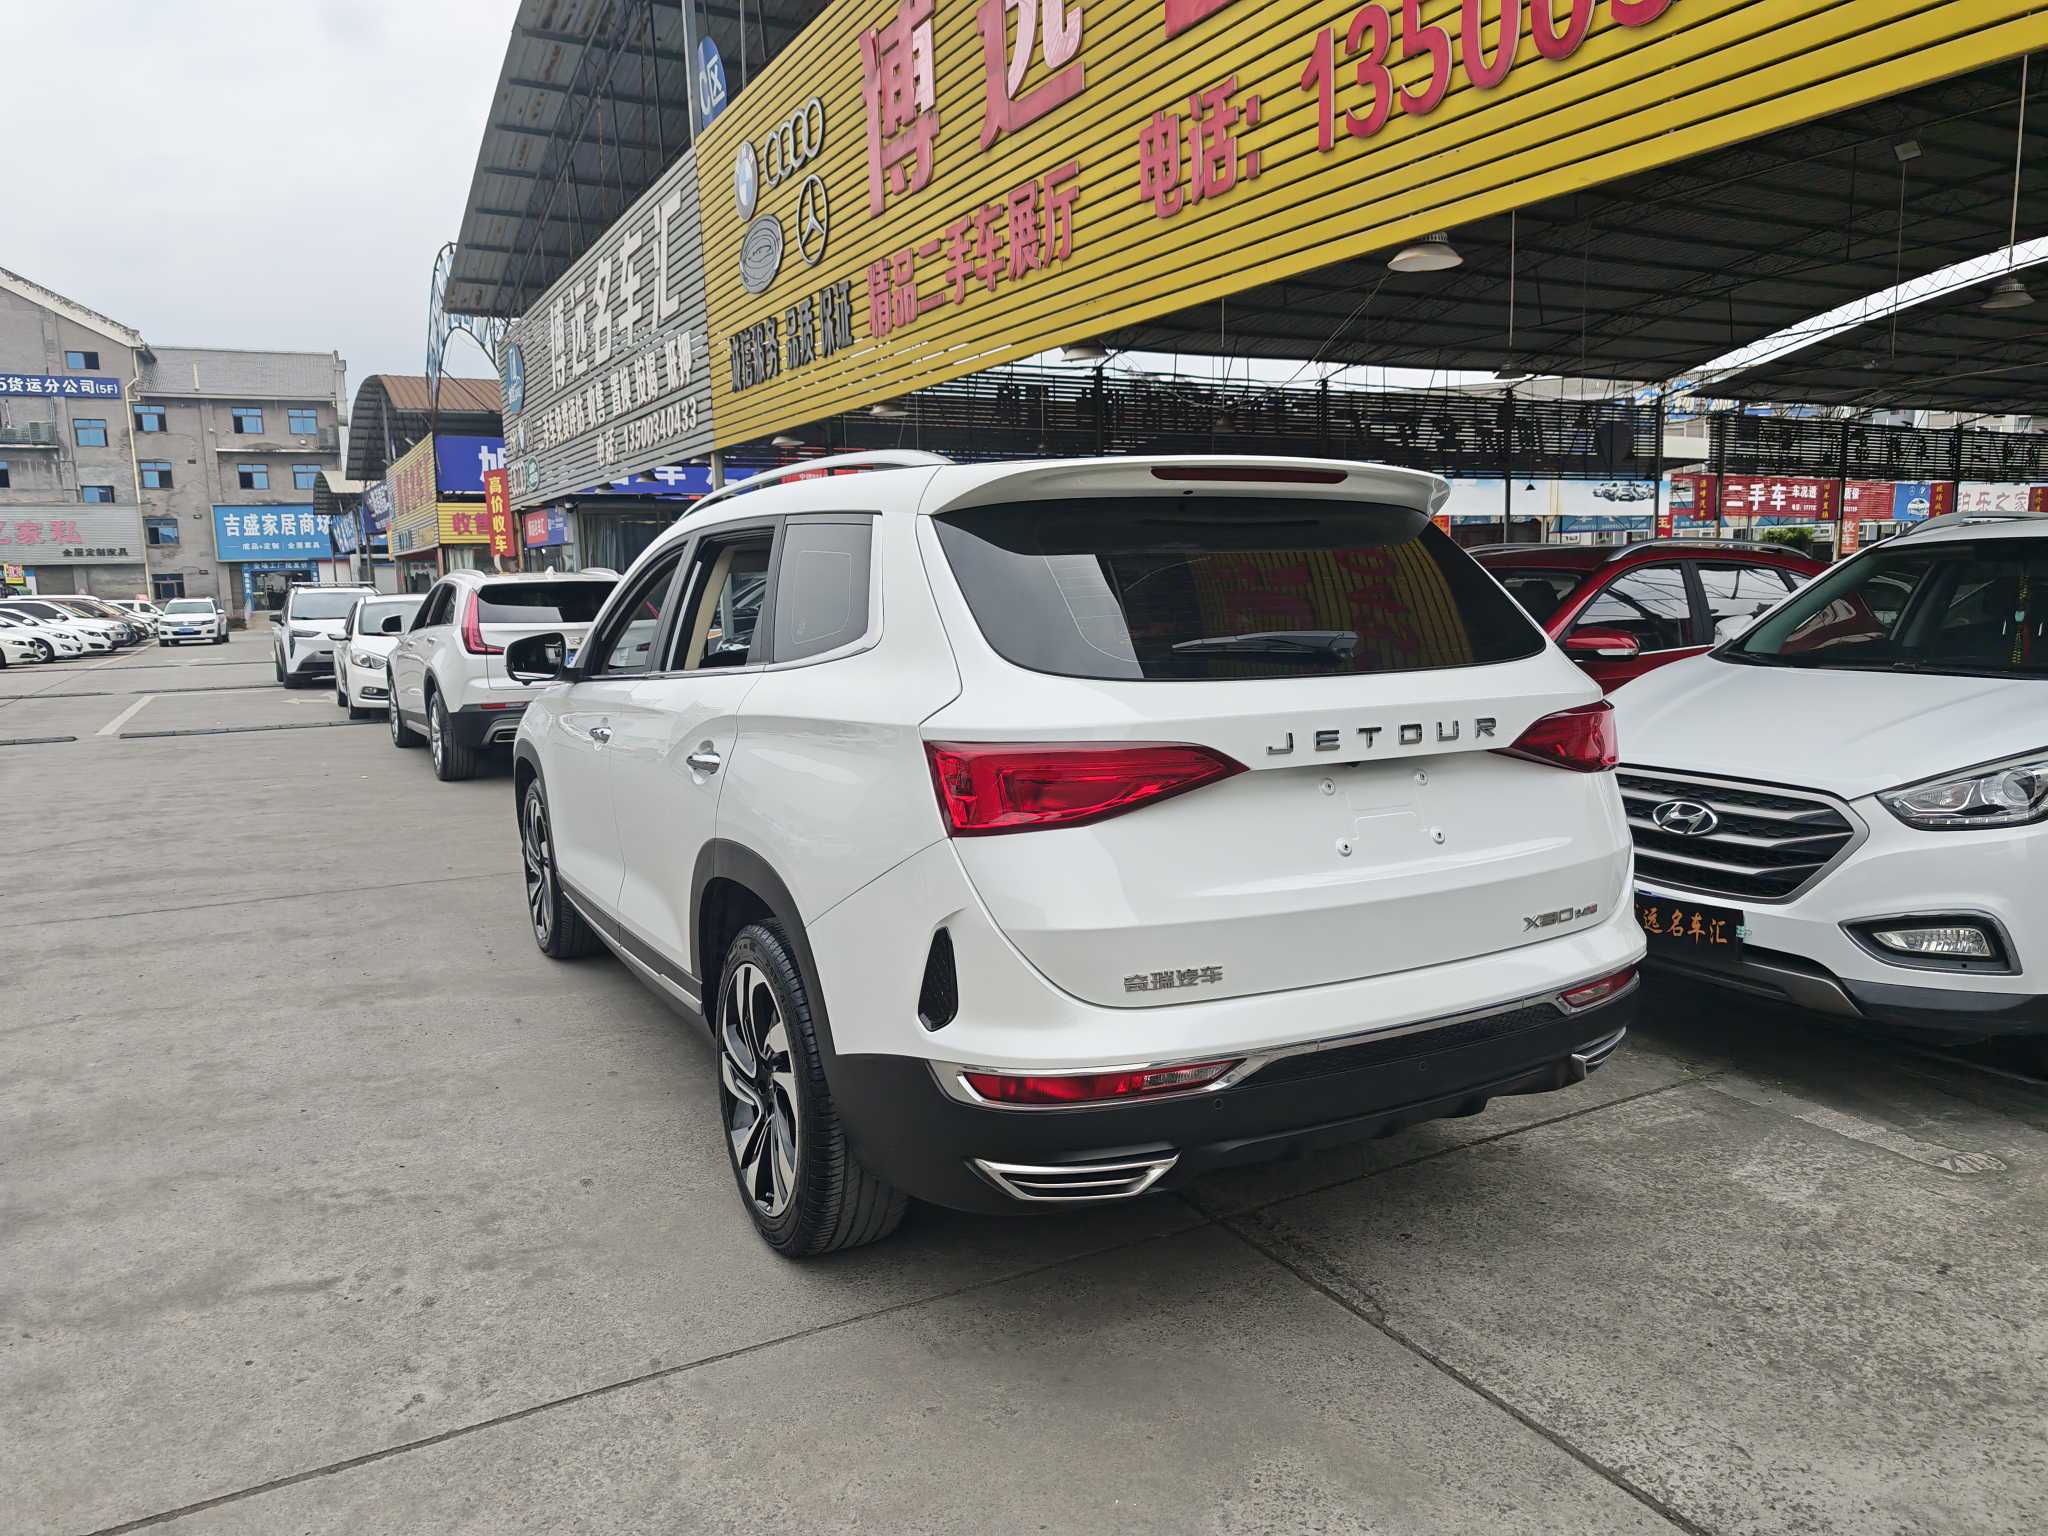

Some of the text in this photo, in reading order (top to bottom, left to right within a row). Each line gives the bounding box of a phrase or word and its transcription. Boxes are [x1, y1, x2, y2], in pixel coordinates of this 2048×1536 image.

[859, 0, 1240, 218] 博远
[1301, 0, 1672, 152] 1350
[866, 160, 1080, 338] 精品二手车展厅
[550, 190, 682, 391] 博远名车汇
[624, 396, 698, 453] 13500340433
[488, 476, 508, 552] 高价收车
[1726, 483, 1787, 511] 二手车
[1266, 717, 1497, 755] JETOUR
[1124, 966, 1223, 993] 奇瑞汽车
